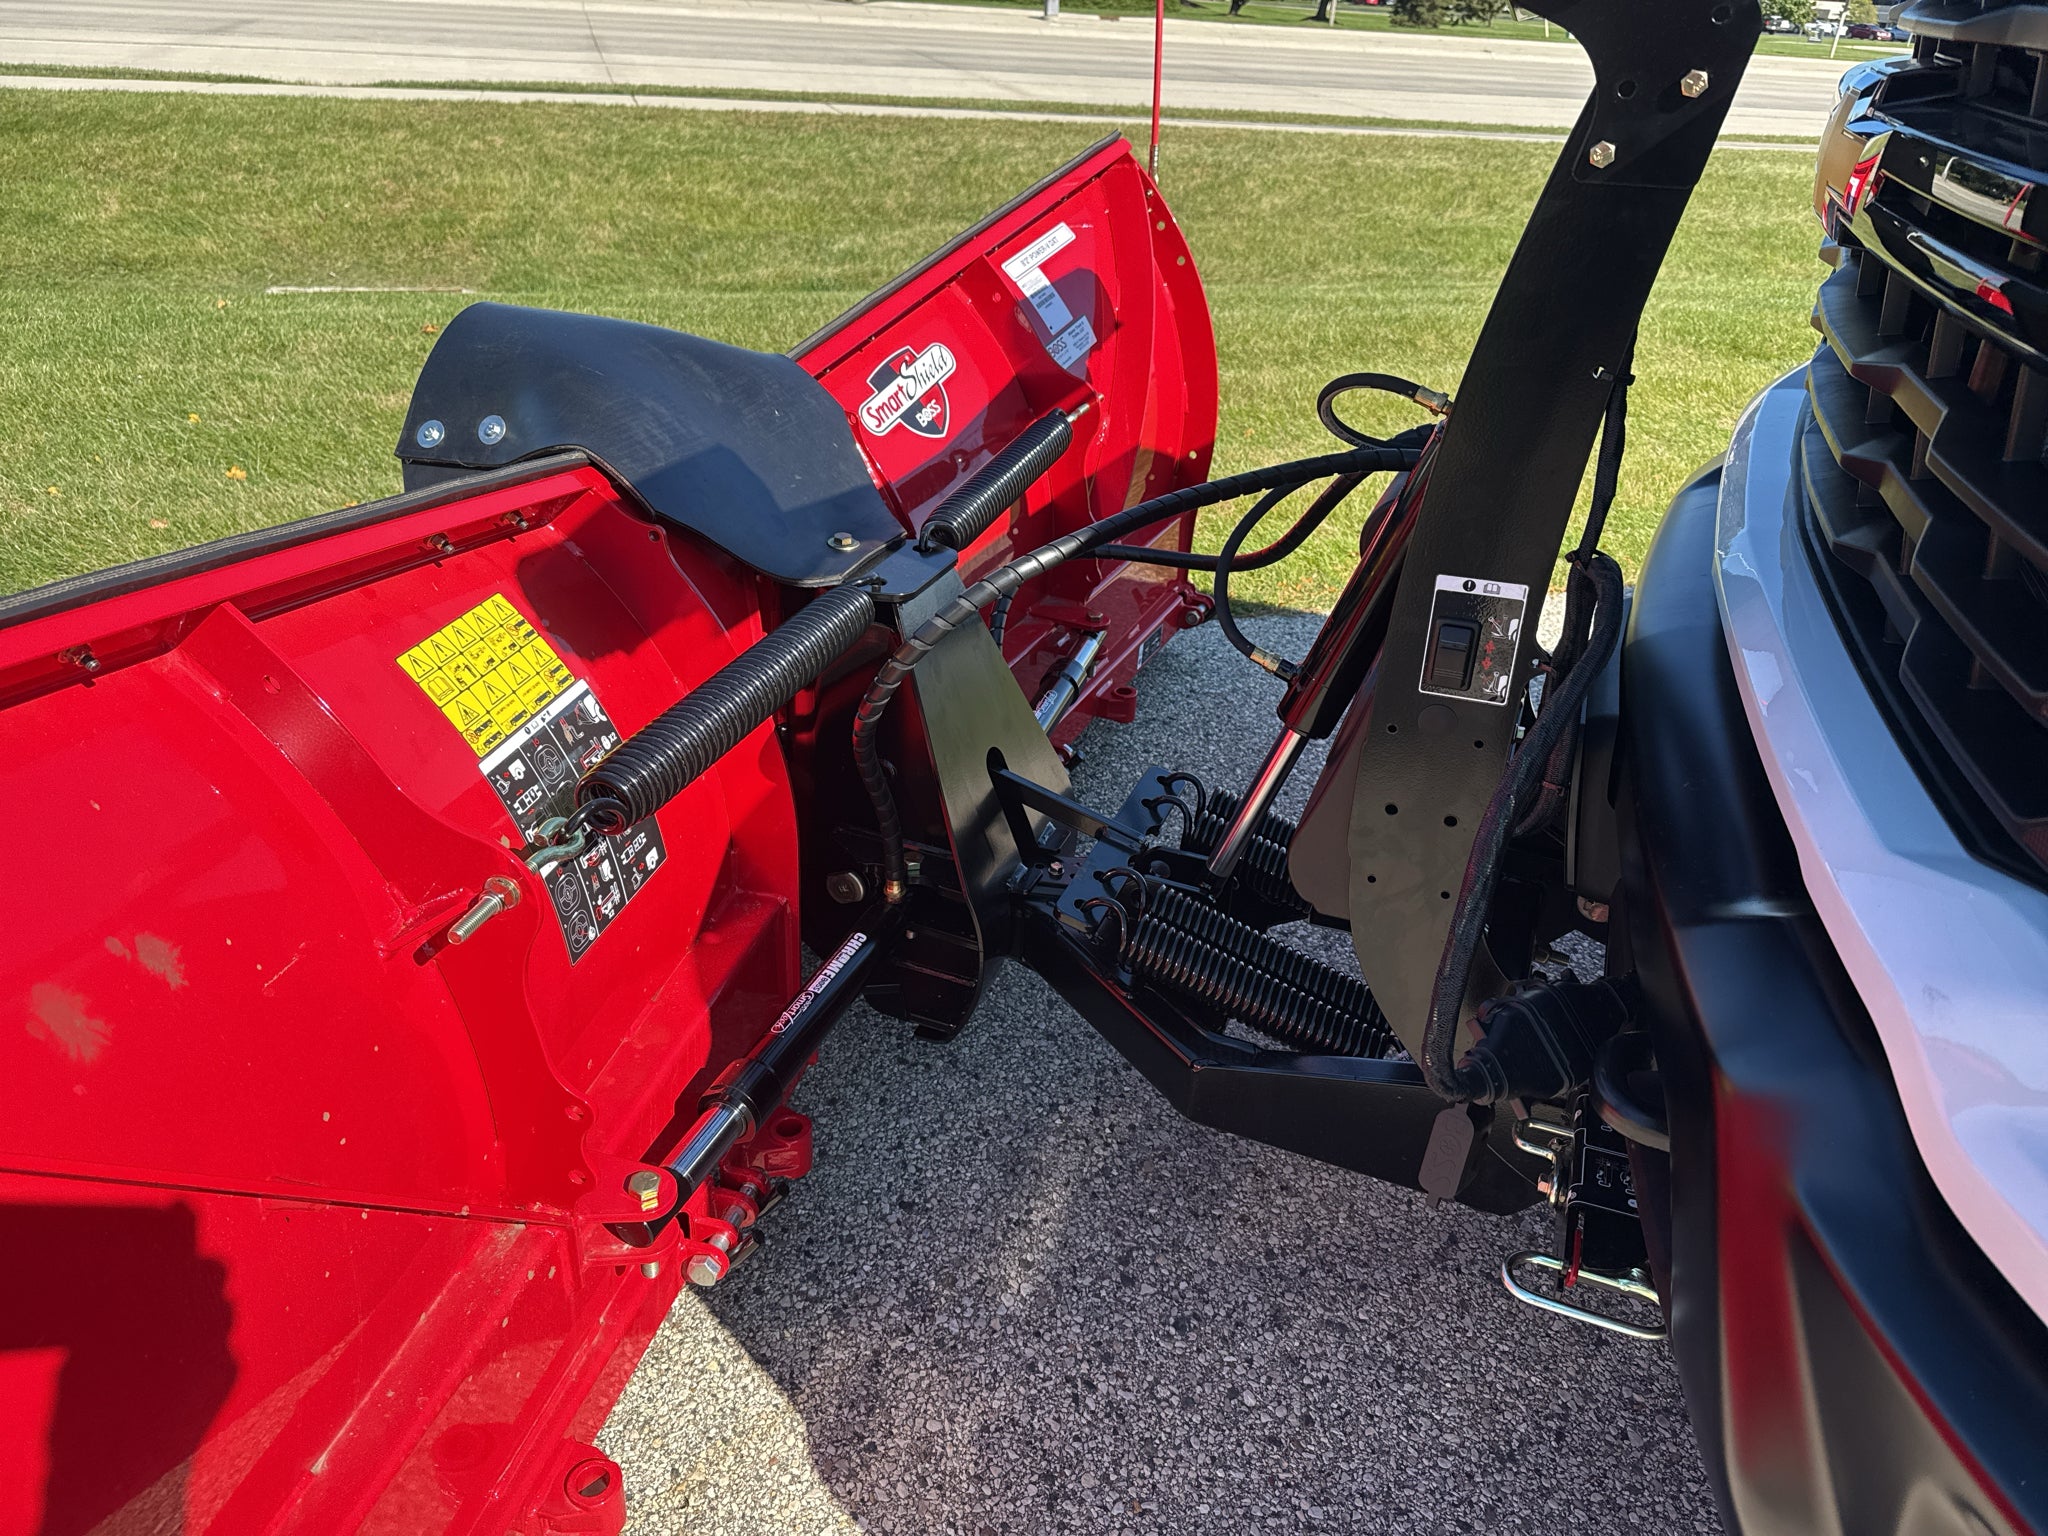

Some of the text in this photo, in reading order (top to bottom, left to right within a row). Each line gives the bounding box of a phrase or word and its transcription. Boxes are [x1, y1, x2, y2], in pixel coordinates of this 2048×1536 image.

[915, 398, 941, 427] BOSS
[821, 932, 867, 979] CHROME
[813, 976, 828, 991] BOSS
